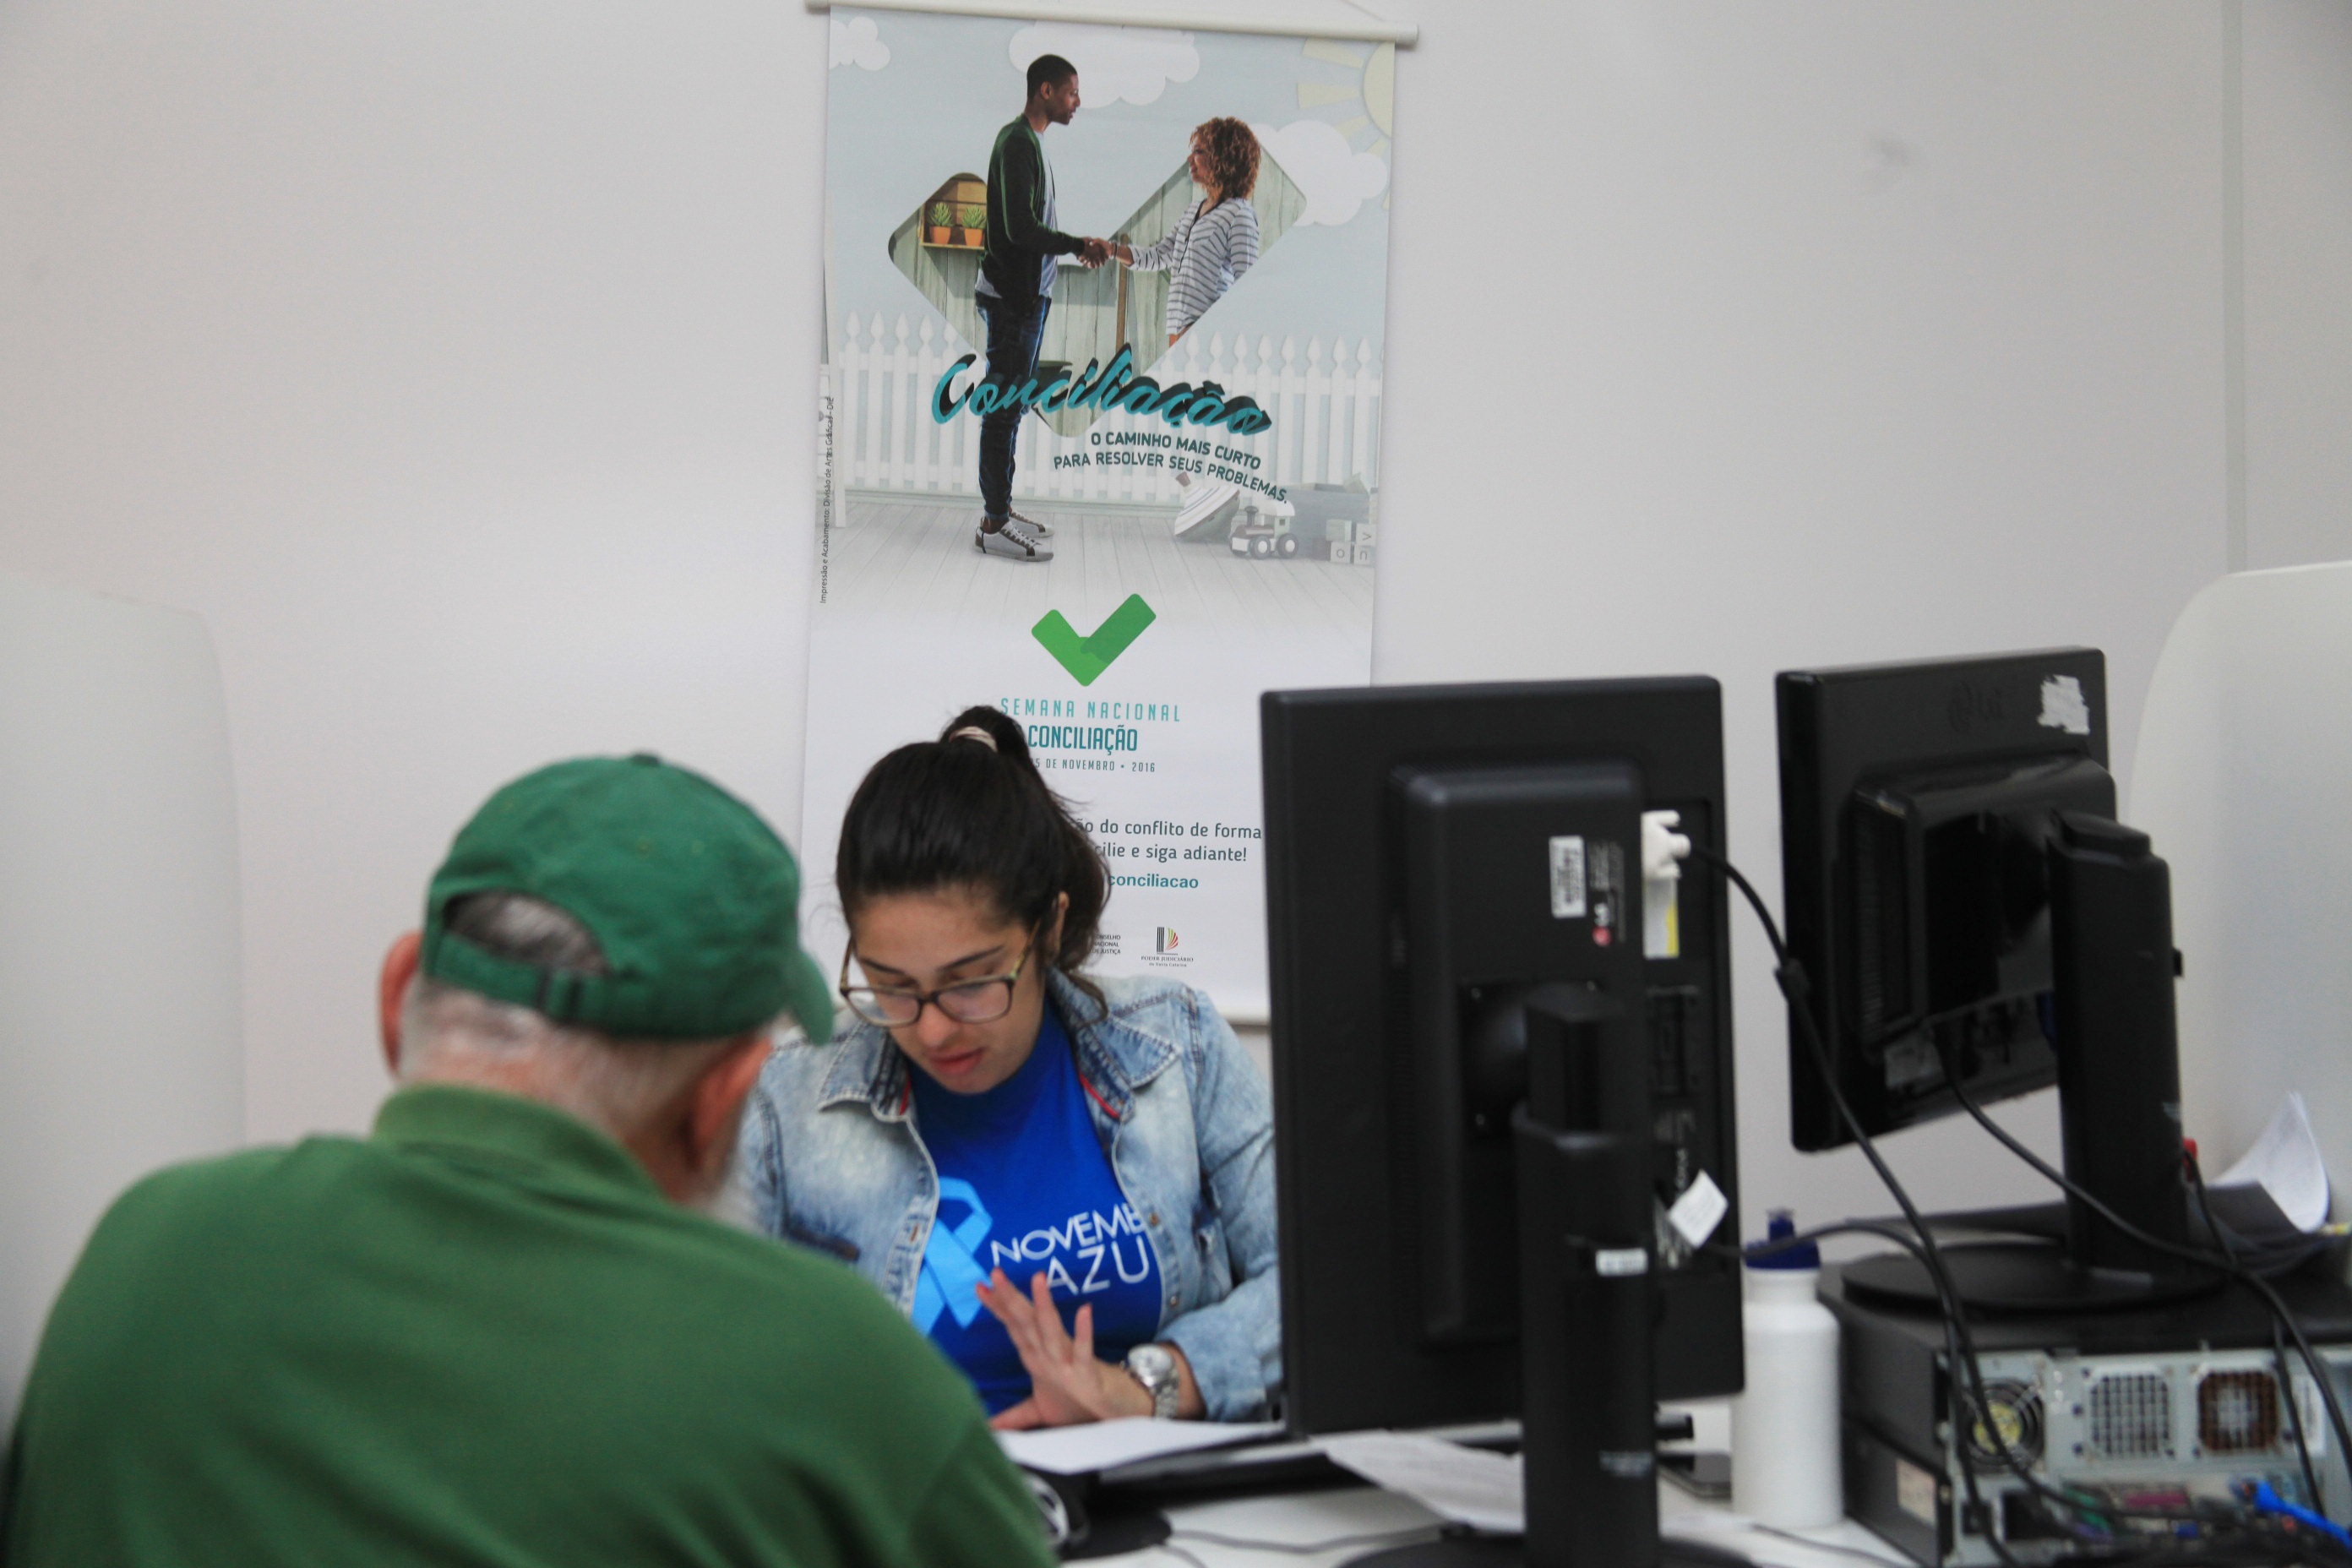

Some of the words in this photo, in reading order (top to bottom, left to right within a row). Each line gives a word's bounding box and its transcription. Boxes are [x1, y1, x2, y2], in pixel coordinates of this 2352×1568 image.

[931, 342, 1271, 436] Conciliação
[1091, 432, 1101, 445] O
[1105, 432, 1172, 449] CAMINHO
[1175, 437, 1211, 456] MAIS
[1214, 444, 1260, 470] CURTO
[825, 469, 831, 478] de
[1054, 453, 1091, 470] PARA
[1096, 451, 1163, 468] RESOLVER
[1169, 455, 1202, 474] SEUS
[1206, 464, 1288, 504] PROBLEMAS.
[821, 508, 830, 558] Acabamento:
[820, 565, 829, 604] Impressão
[1000, 698, 1075, 717] SEMANA
[1087, 701, 1180, 722] NACIONAL
[1027, 724, 1138, 755] CONCILIAÇÃO
[1046, 758, 1057, 769] DE
[1062, 759, 1115, 771] NOVEMBRO
[1132, 762, 1155, 773] 2016
[1100, 818, 1119, 834] do
[1124, 820, 1184, 836] conflito
[1190, 822, 1209, 837] de
[1215, 823, 1261, 839] forma
[1094, 841, 1125, 858] cilie
[1131, 847, 1140, 858] e
[1146, 844, 1177, 863] siga
[1184, 846, 1247, 862] adiante!
[1108, 873, 1199, 889] conciliacao
[991, 1202, 1146, 1266] NOVEMB
[1047, 1234, 1149, 1295] AZU
